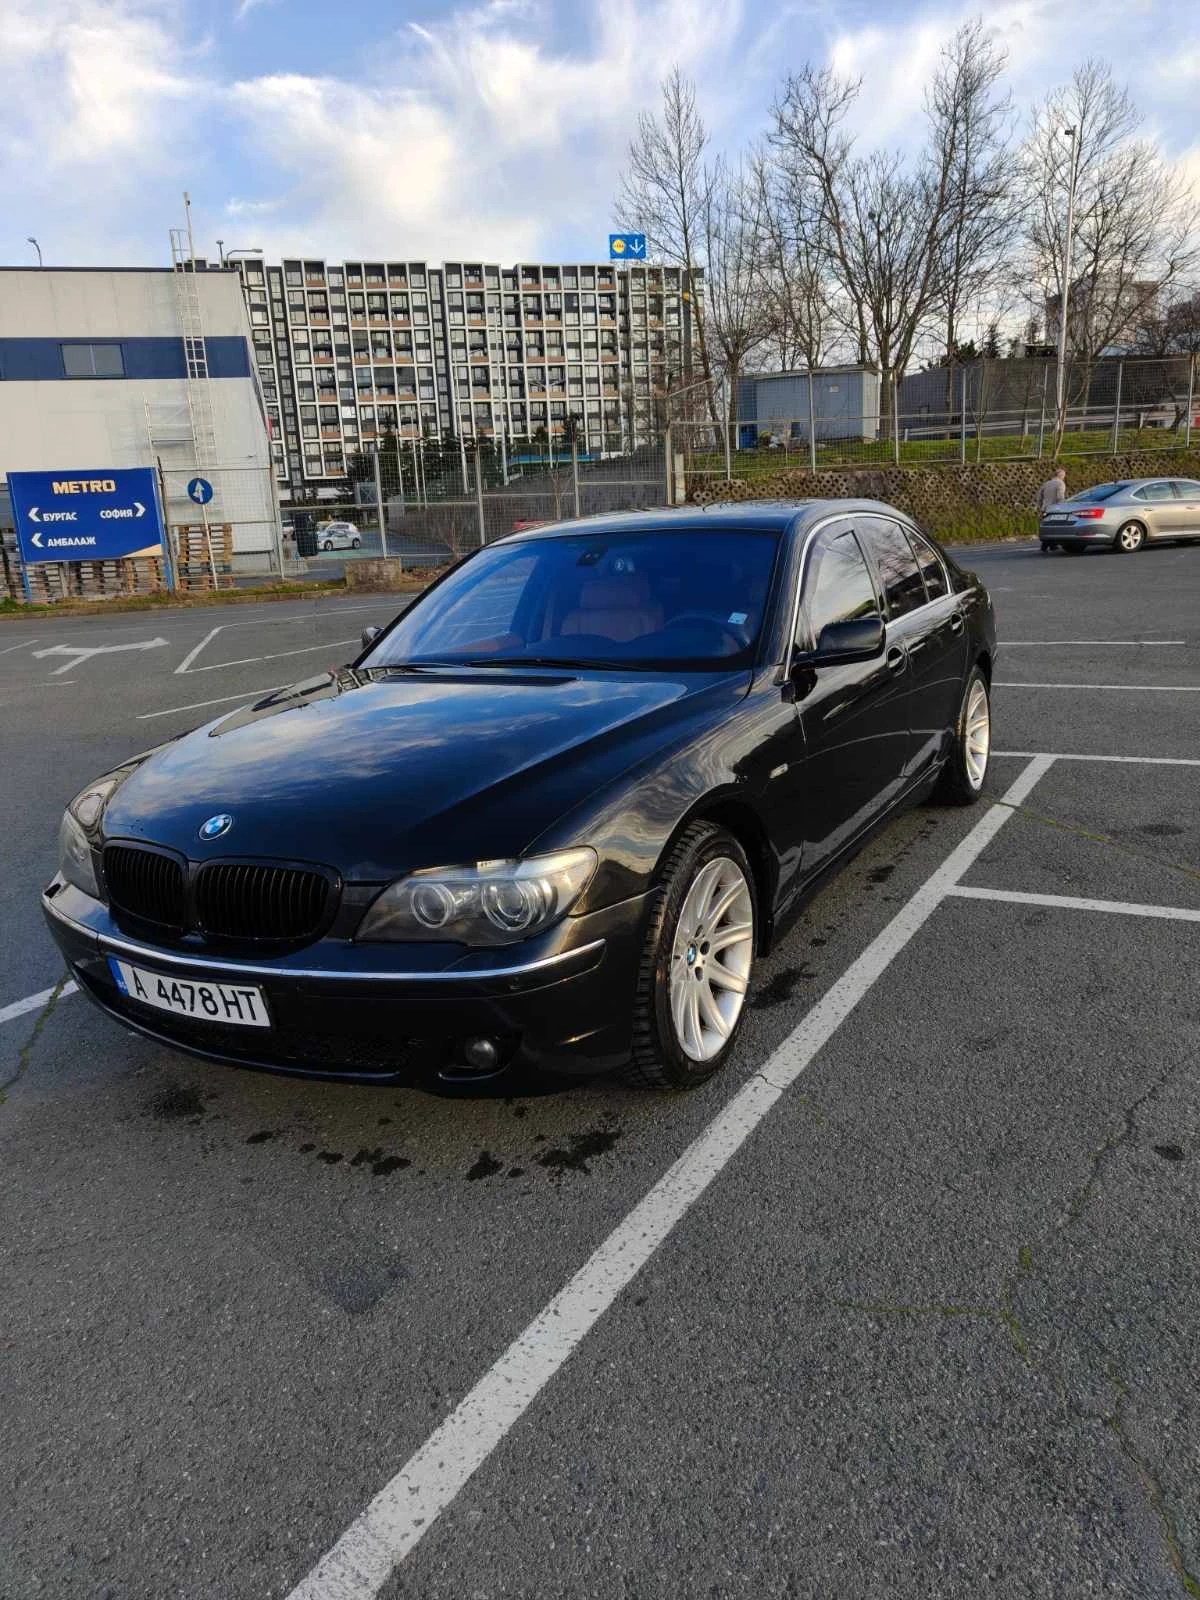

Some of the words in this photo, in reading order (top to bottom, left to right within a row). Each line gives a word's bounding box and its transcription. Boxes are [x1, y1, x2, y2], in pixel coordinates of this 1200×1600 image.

[52, 480, 116, 494] METRO
[43, 511, 77, 522] БУРГАС
[100, 509, 133, 519] СОФИЯ
[47, 536, 96, 547] АМБАЛАЖ
